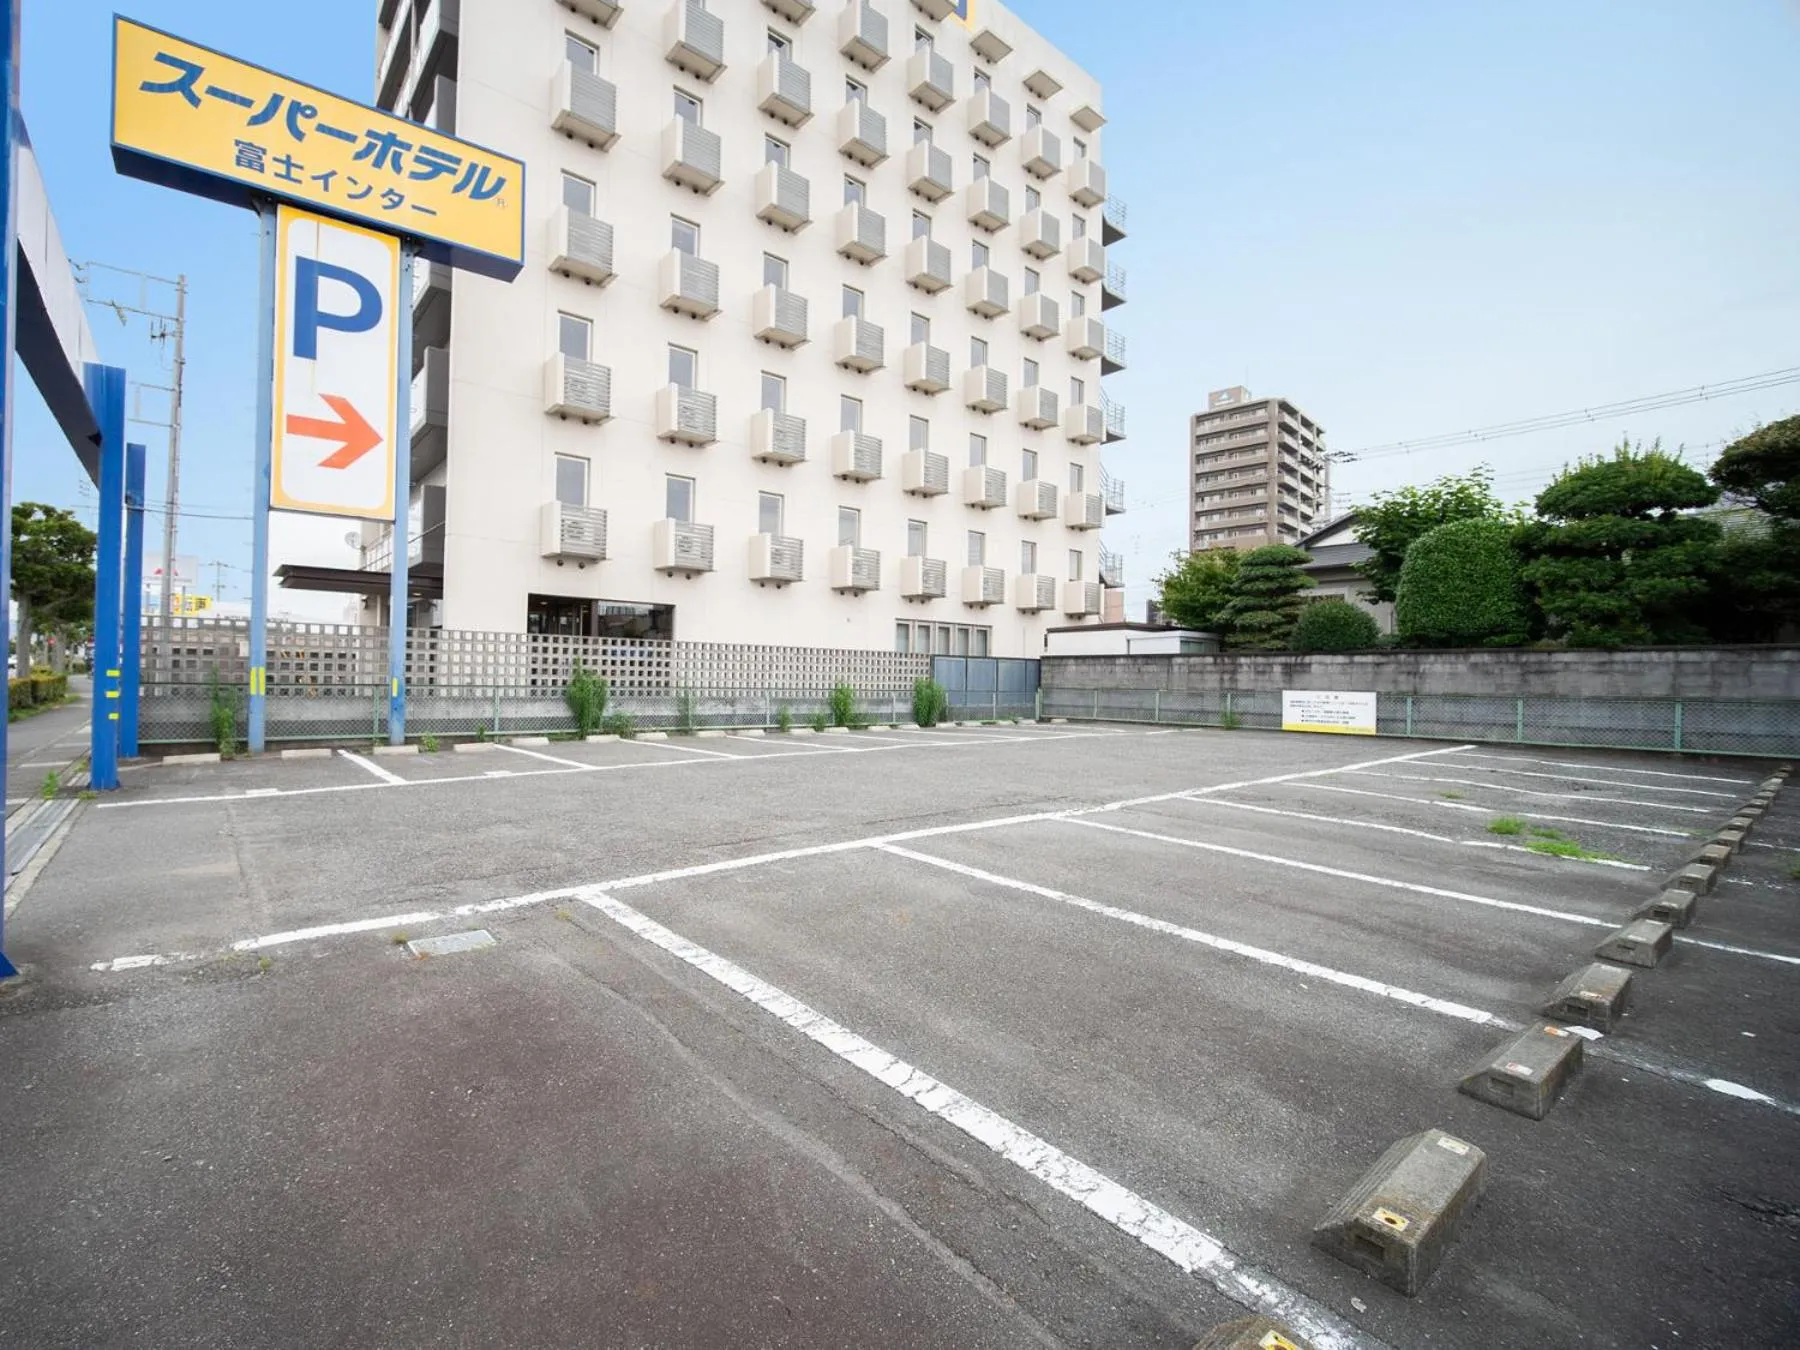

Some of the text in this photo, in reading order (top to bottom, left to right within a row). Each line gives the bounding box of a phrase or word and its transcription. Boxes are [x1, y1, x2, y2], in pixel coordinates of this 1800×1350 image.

[139, 51, 507, 202] スーパーホテル
[233, 138, 438, 217] 富士インター
[292, 254, 384, 361] P
